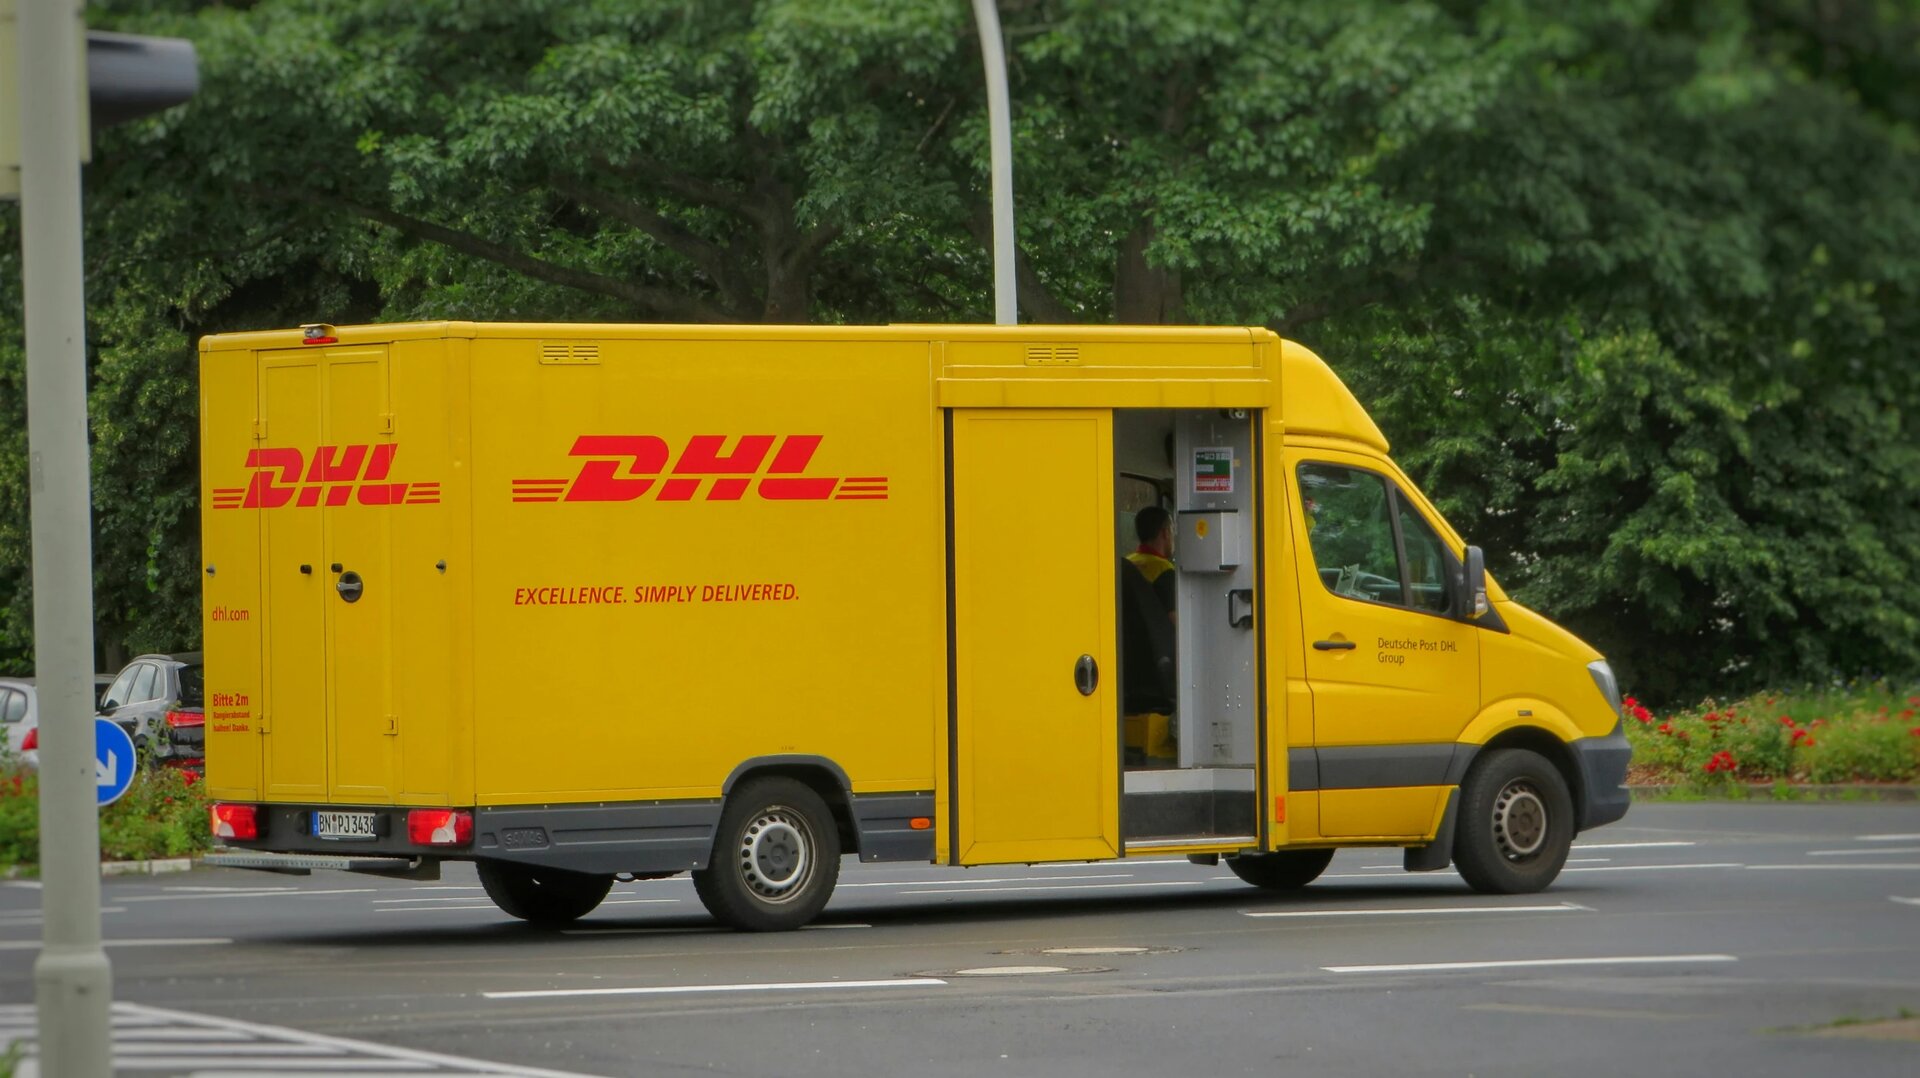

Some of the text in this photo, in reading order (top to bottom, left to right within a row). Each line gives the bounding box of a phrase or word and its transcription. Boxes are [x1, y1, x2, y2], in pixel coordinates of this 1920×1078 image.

[242, 443, 409, 508] DHL
[563, 434, 840, 502] DHL
[514, 583, 800, 605] EXCELLENCE. SIMPLY DELIVERED.
[212, 606, 249, 621] dhl.com
[1378, 638, 1457, 652] Deutsche Post DHL
[1378, 652, 1405, 666] Group
[213, 692, 249, 707] Bitte 2m
[319, 814, 331, 833] BN
[337, 815, 350, 834] PJ
